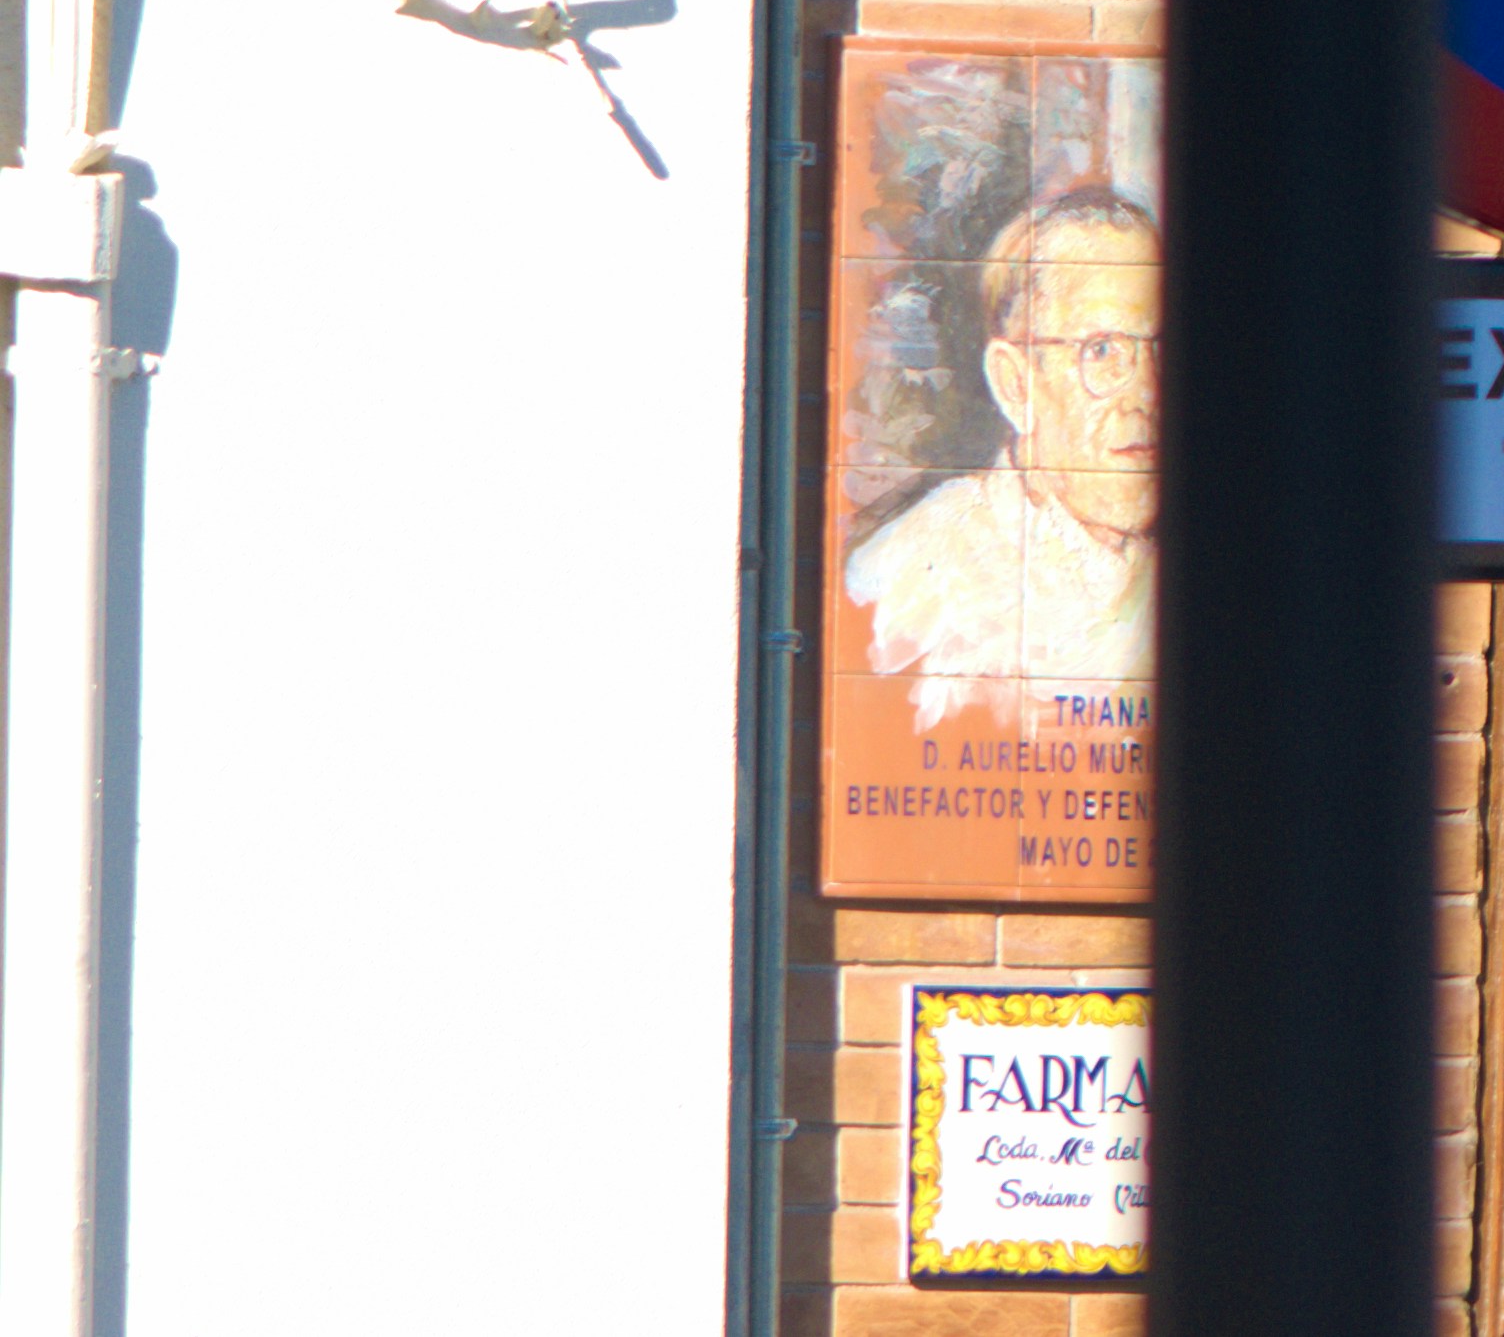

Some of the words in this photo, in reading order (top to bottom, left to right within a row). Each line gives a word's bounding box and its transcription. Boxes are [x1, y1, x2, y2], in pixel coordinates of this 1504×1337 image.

[1055, 695, 1151, 727] TRIANA
[923, 740, 949, 771] D.
[960, 741, 1077, 773] AURELIO
[847, 785, 1024, 819] BENEFACTOR
[1038, 790, 1053, 819] Y
[1020, 835, 1092, 868] MAYO
[1105, 837, 1138, 868] DE
[976, 1134, 1045, 1166] Lcda.
[1105, 1136, 1142, 1162] del
[996, 1178, 1094, 1209] Soriano
